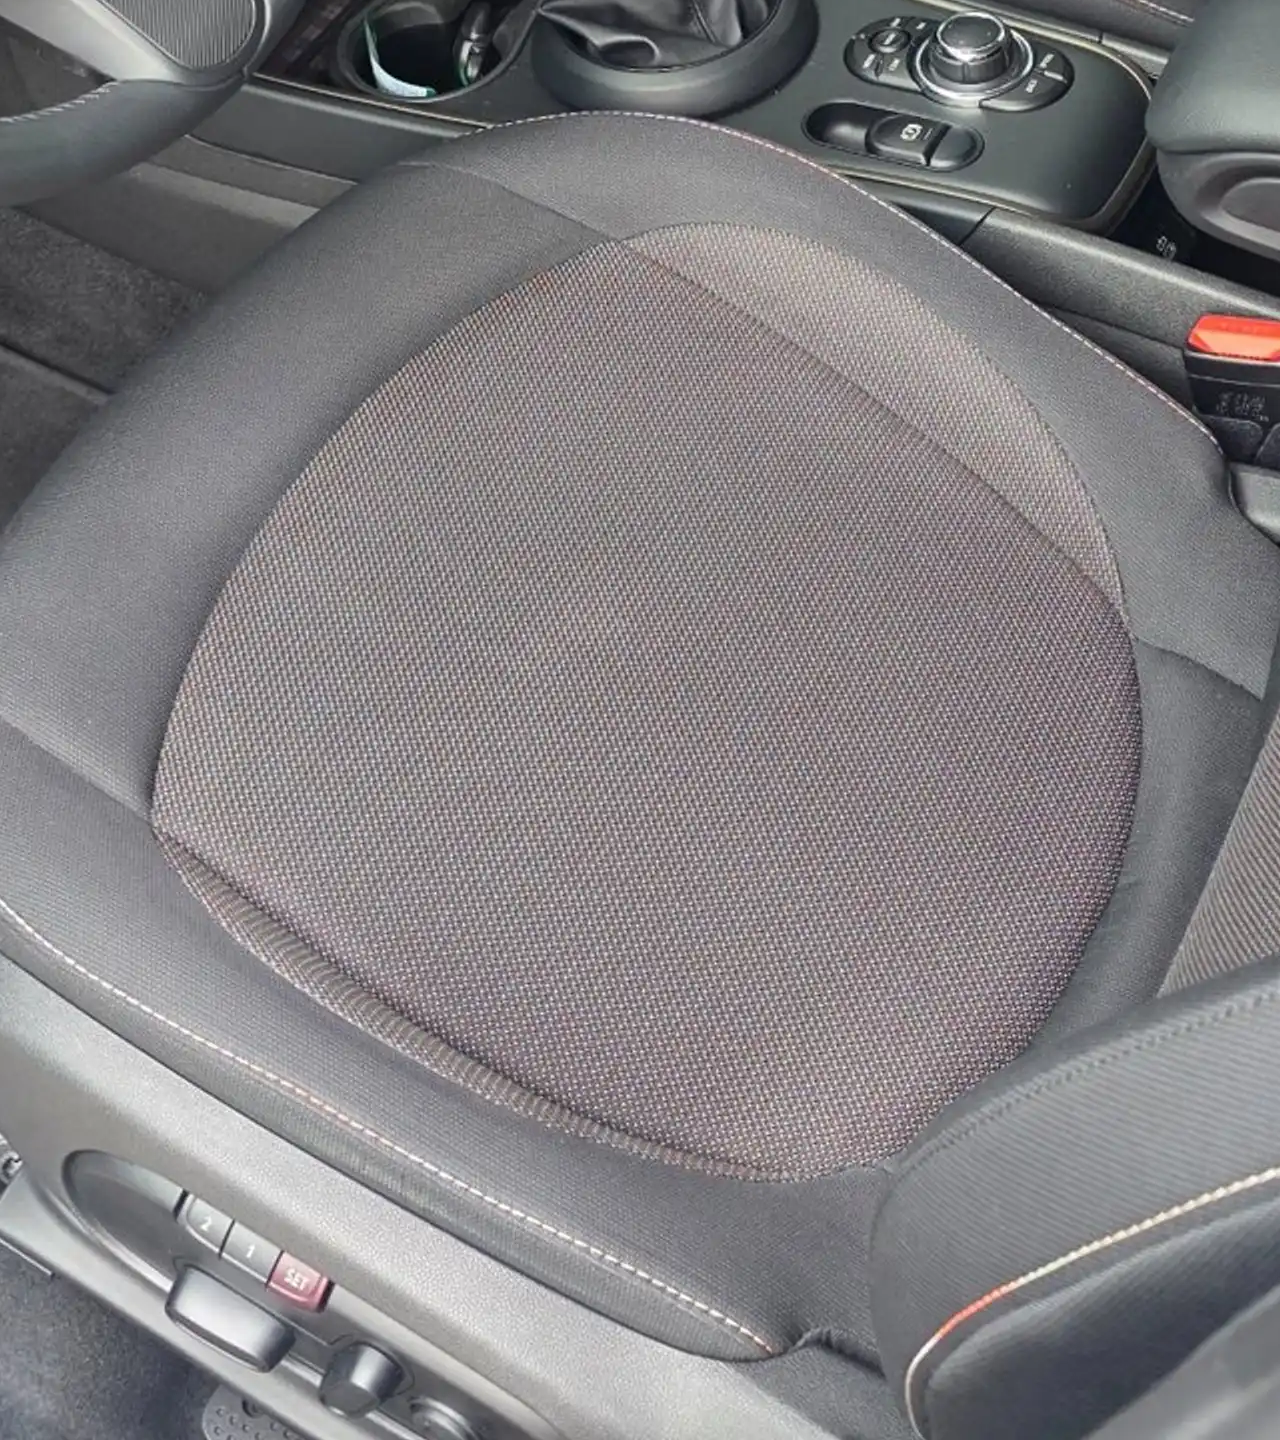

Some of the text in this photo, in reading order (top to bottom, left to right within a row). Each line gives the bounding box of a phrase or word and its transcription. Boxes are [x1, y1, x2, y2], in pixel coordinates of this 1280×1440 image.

[201, 1216, 213, 1232] 2
[246, 1243, 256, 1259] 1
[283, 1266, 307, 1291] SET
